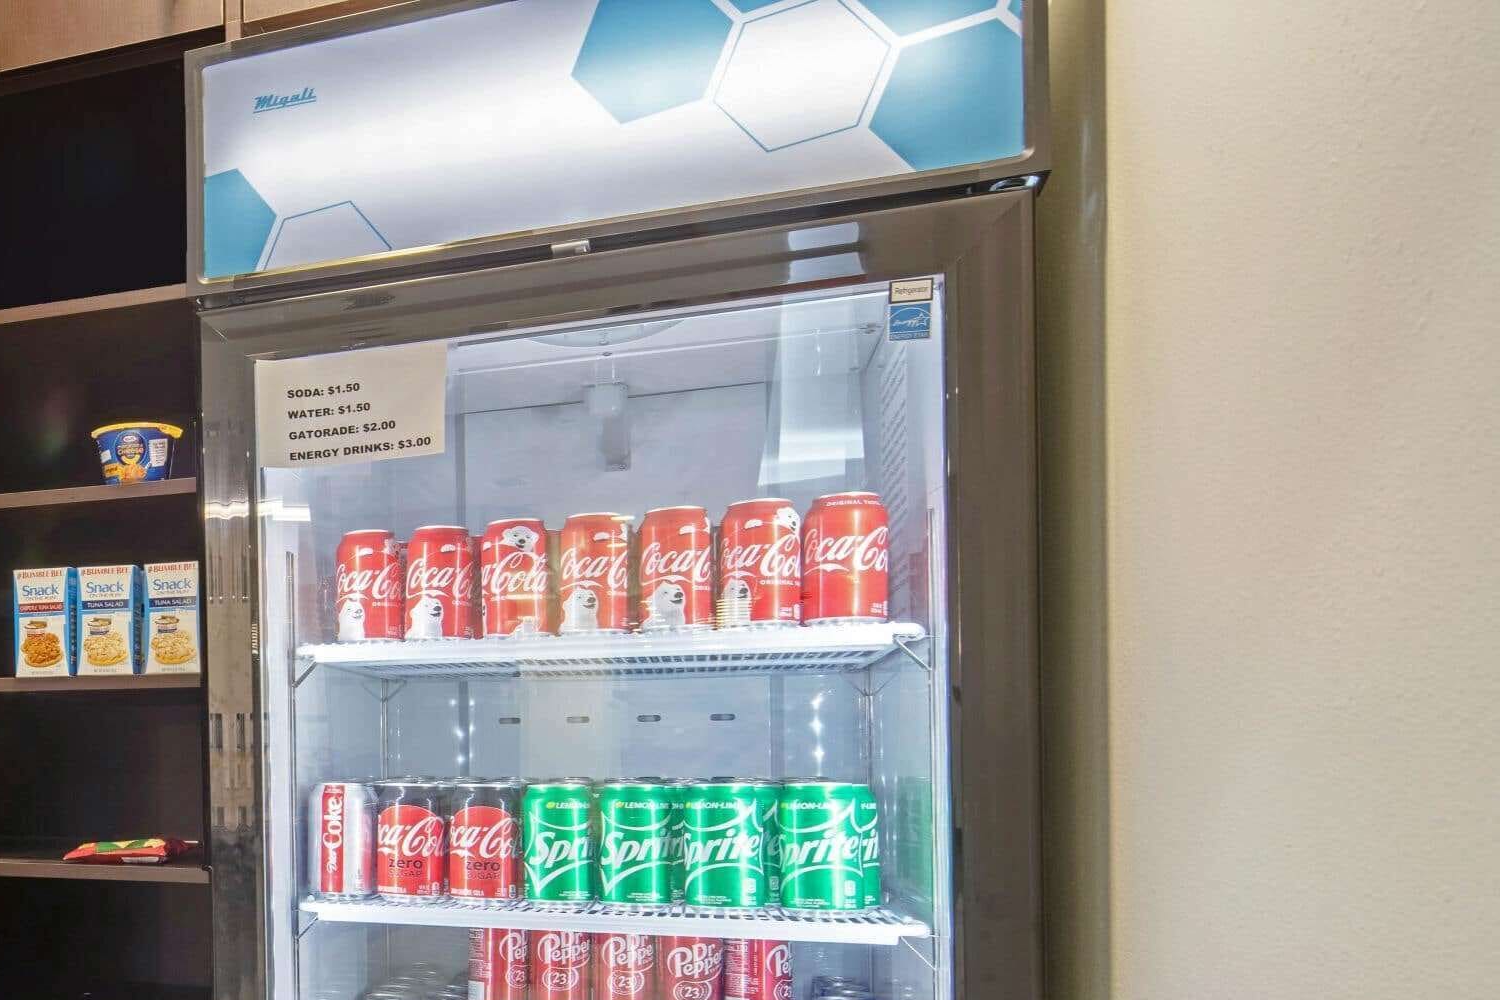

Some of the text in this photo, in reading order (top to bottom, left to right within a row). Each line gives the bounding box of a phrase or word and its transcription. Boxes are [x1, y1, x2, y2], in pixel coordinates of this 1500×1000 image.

[254, 87, 316, 114] Migali
[287, 382, 360, 399] SODA: $1.50
[288, 402, 371, 420] WATER: $1.50
[288, 420, 396, 440] GATORADE: $2.00
[289, 436, 431, 461] ENERGY DRINKS: $3.00
[22, 584, 60, 597] Snack
[86, 581, 124, 594] Snack
[153, 578, 192, 591] Snack
[323, 790, 344, 848] Coke
[388, 859, 422, 869] zero
[467, 861, 500, 872] zero
[694, 943, 716, 958] Dr
[553, 972, 567, 984] 23
[618, 976, 633, 988] 23
[685, 985, 700, 999] 23
